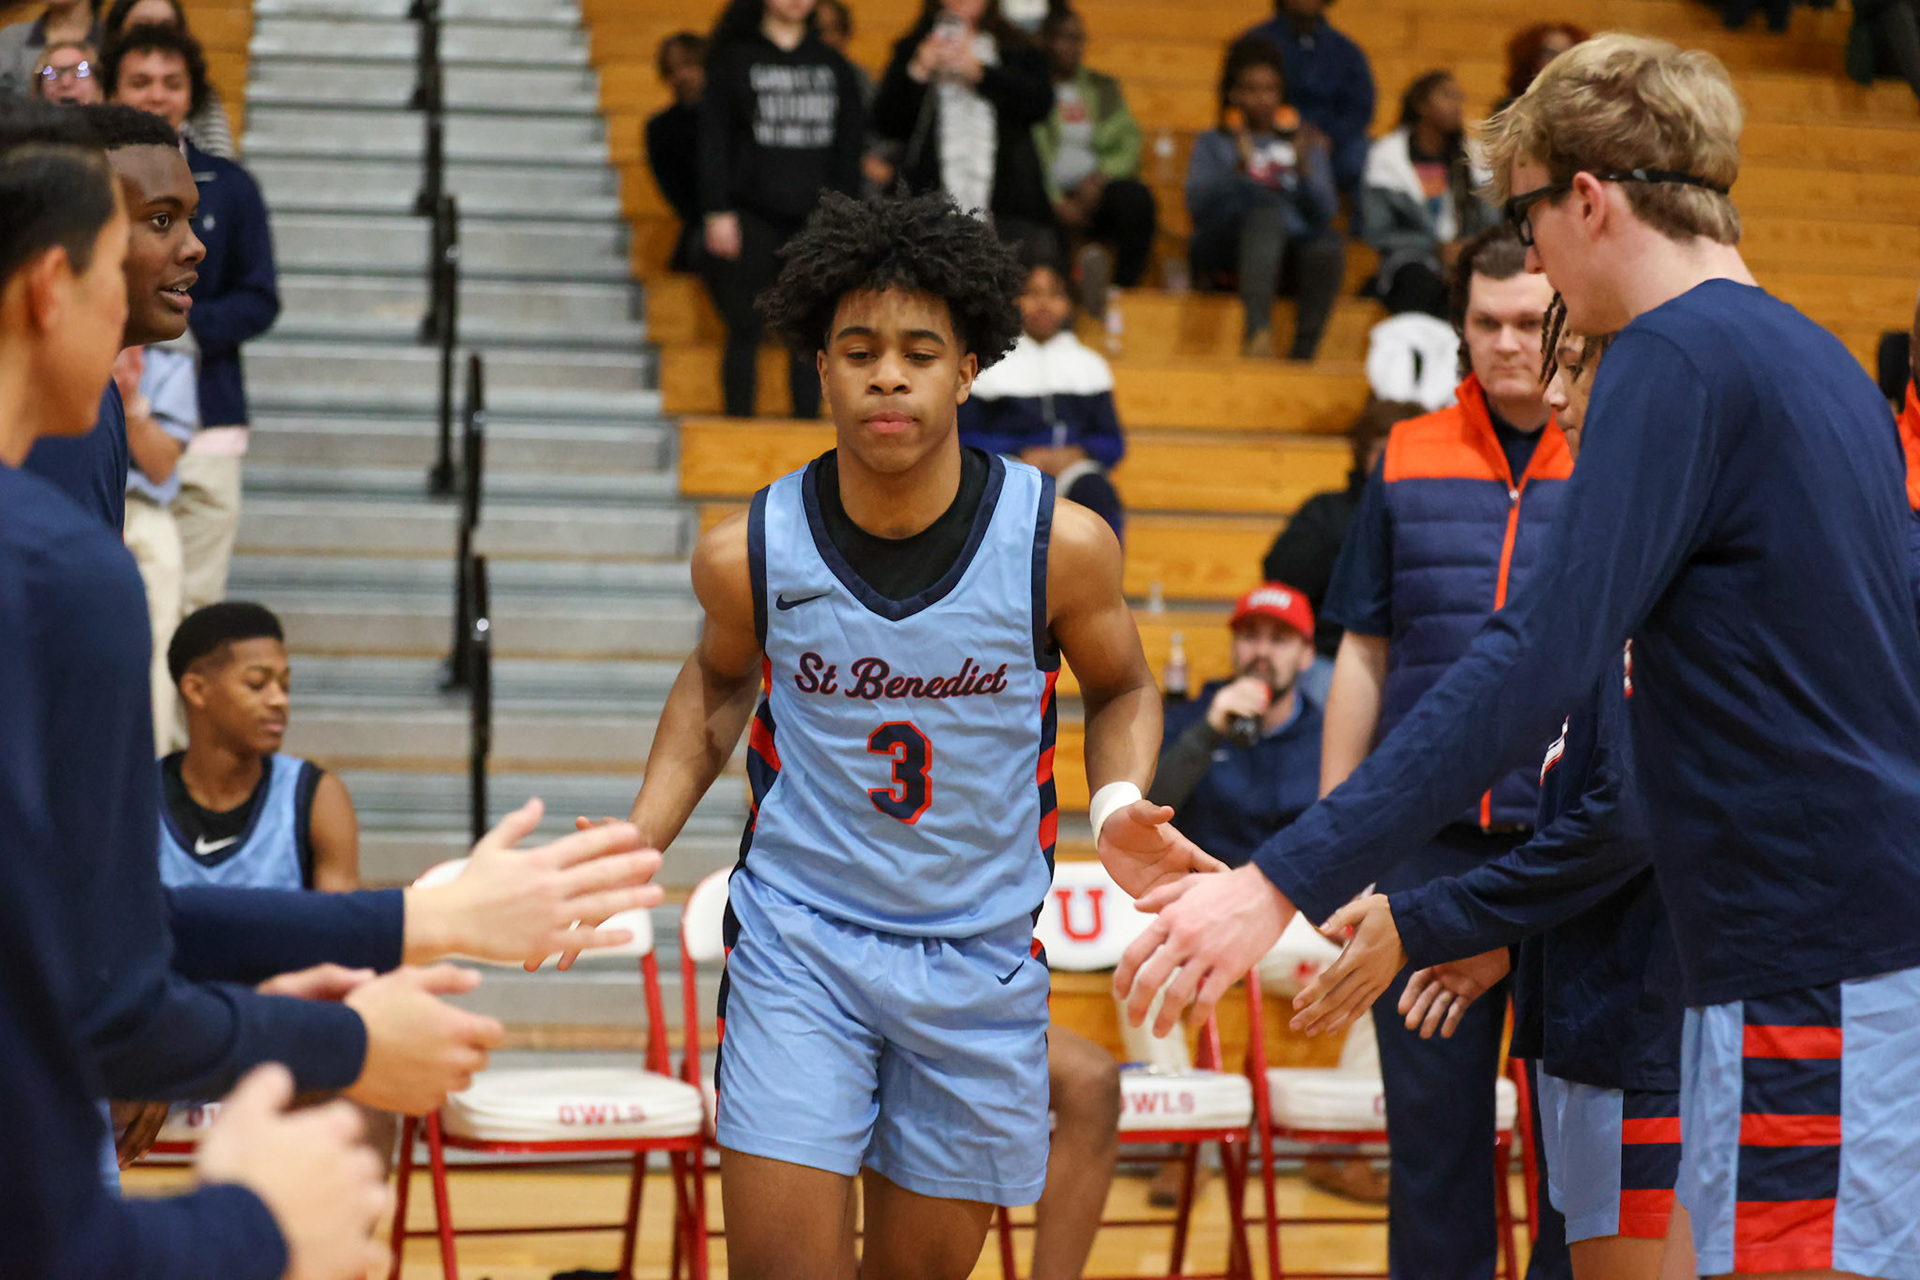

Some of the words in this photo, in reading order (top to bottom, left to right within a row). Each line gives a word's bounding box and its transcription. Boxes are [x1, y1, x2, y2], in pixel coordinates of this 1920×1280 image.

[794, 652, 838, 695] St
[844, 656, 1008, 700] Benedict
[867, 720, 932, 825] 3
[1053, 888, 1105, 942] U
[559, 1103, 645, 1126] OWLS
